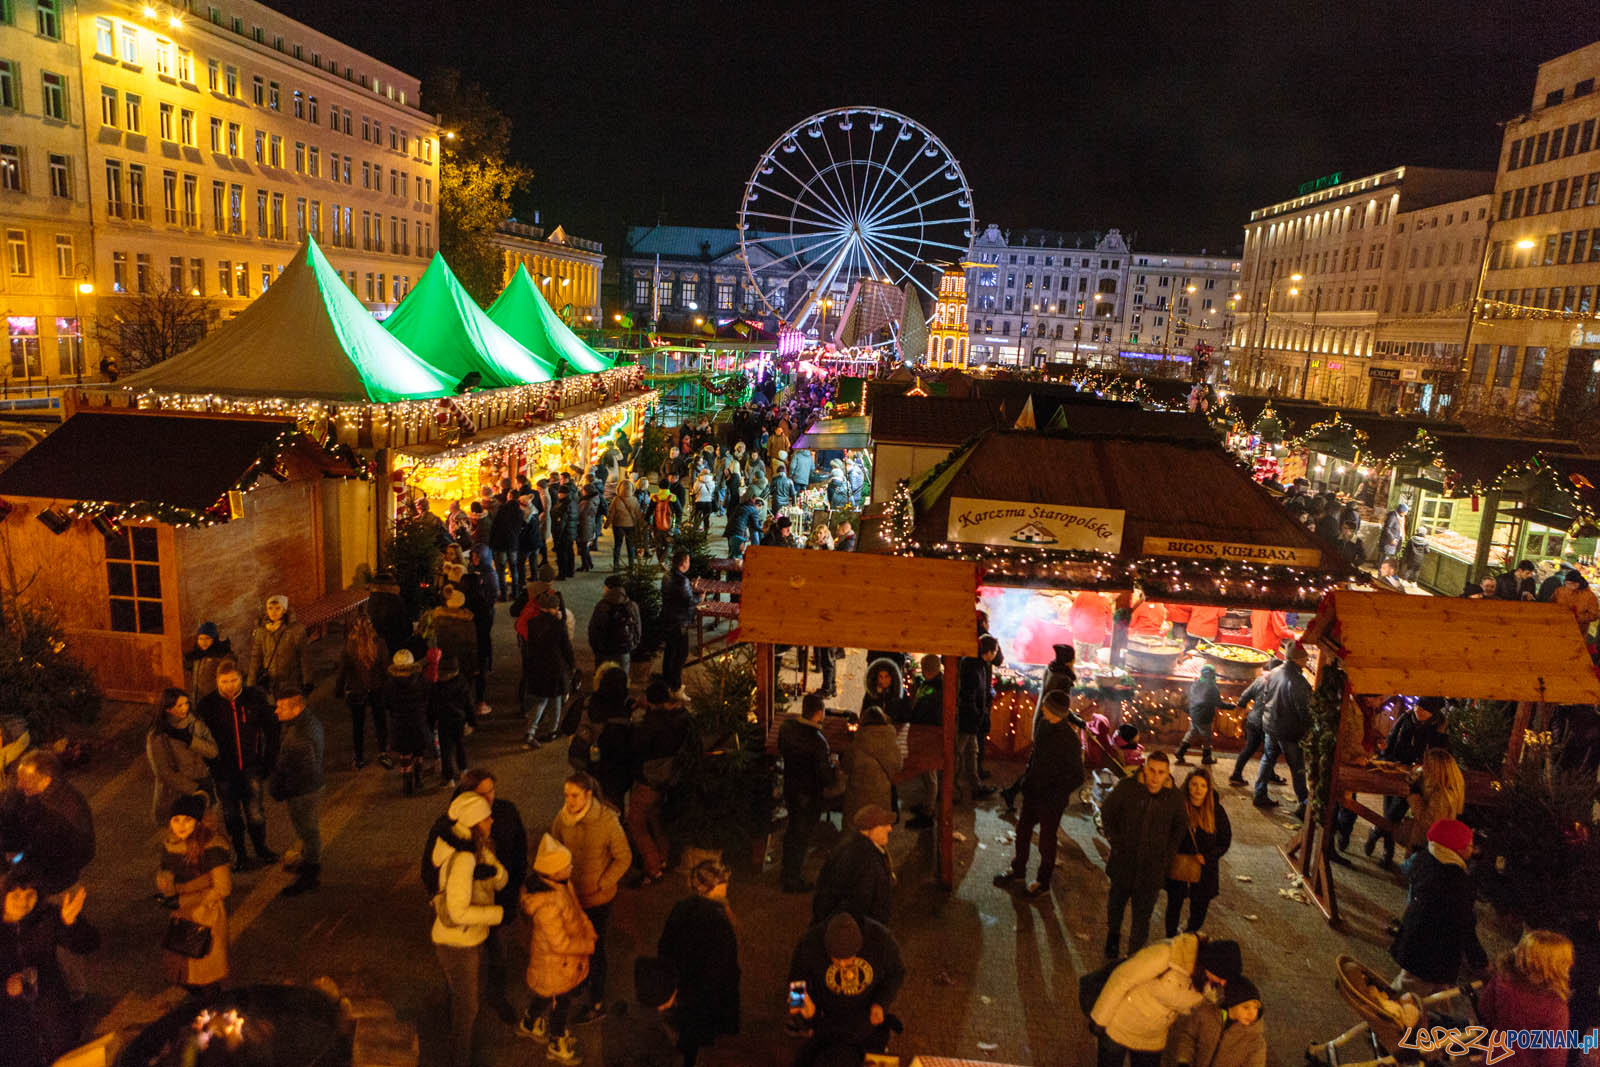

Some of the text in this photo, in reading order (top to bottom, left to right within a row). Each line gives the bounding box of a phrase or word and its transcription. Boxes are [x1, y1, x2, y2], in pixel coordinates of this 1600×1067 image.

[958, 506, 1114, 539] Karczma Staropolska
[1167, 541, 1218, 556] BIGOS,
